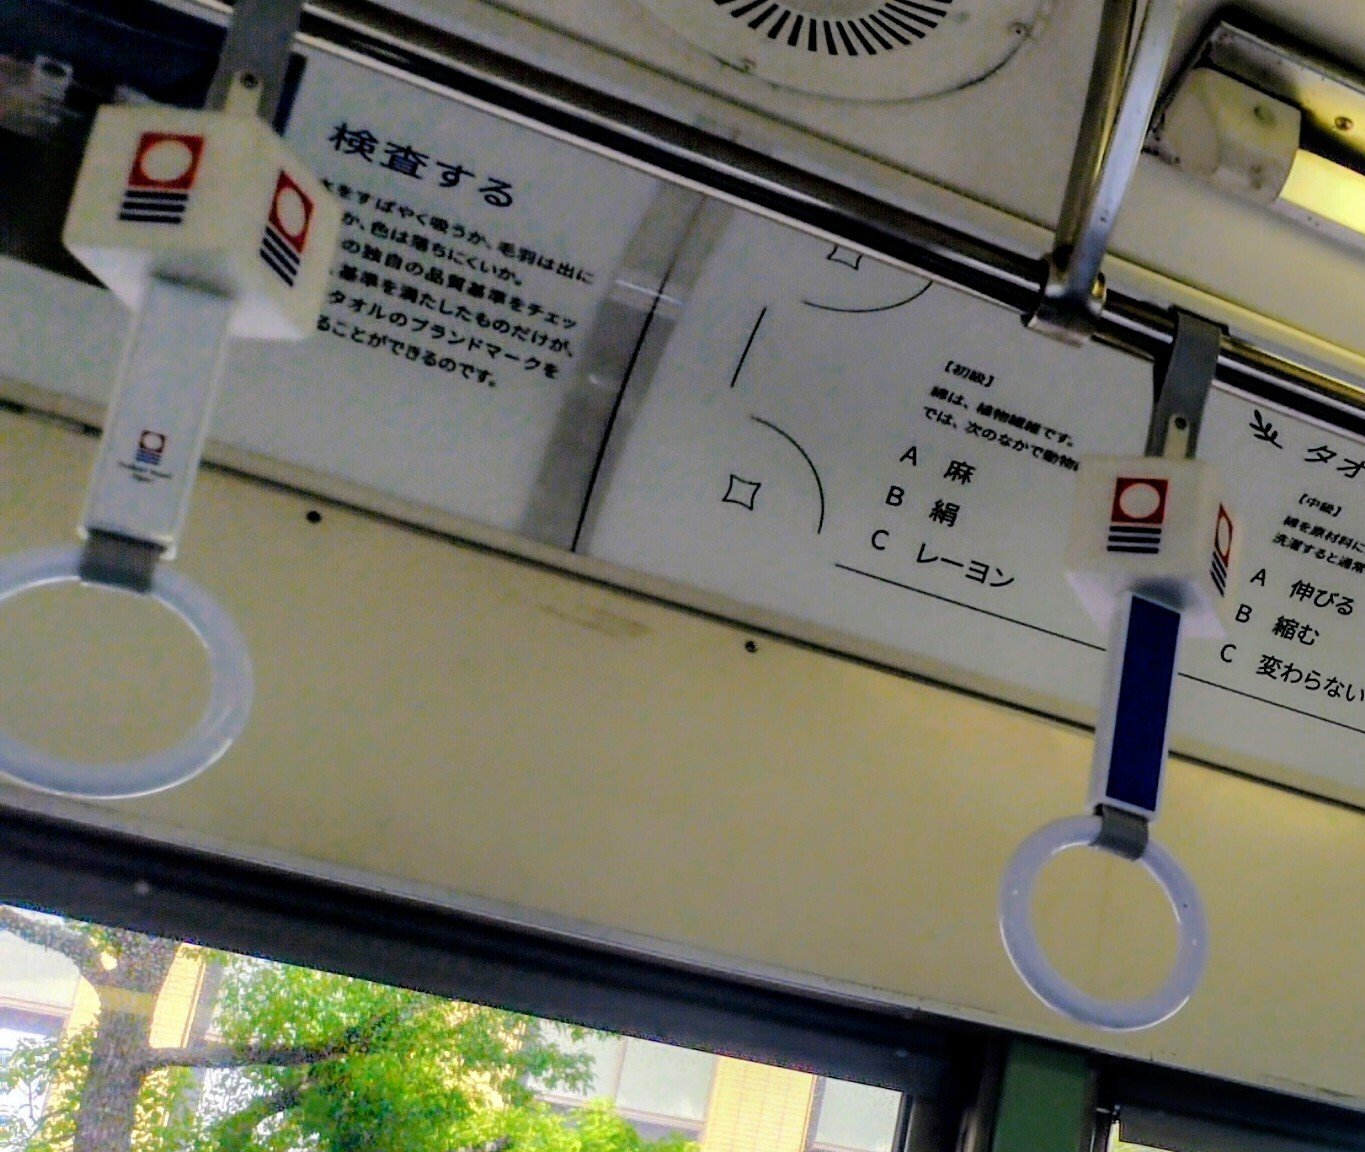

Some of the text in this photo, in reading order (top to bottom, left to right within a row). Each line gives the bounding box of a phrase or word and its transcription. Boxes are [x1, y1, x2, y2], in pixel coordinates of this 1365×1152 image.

[327, 121, 514, 208] 検査する
[900, 446, 976, 485] A 麻
[923, 406, 1079, 472] では、次のなかで動物
[885, 485, 961, 528] B 絹
[871, 529, 1015, 588] C レーヨン
[1250, 568, 1355, 617] A 伸びる
[1235, 604, 1320, 647] B 縮む
[1220, 643, 1365, 703] C 変わらない
